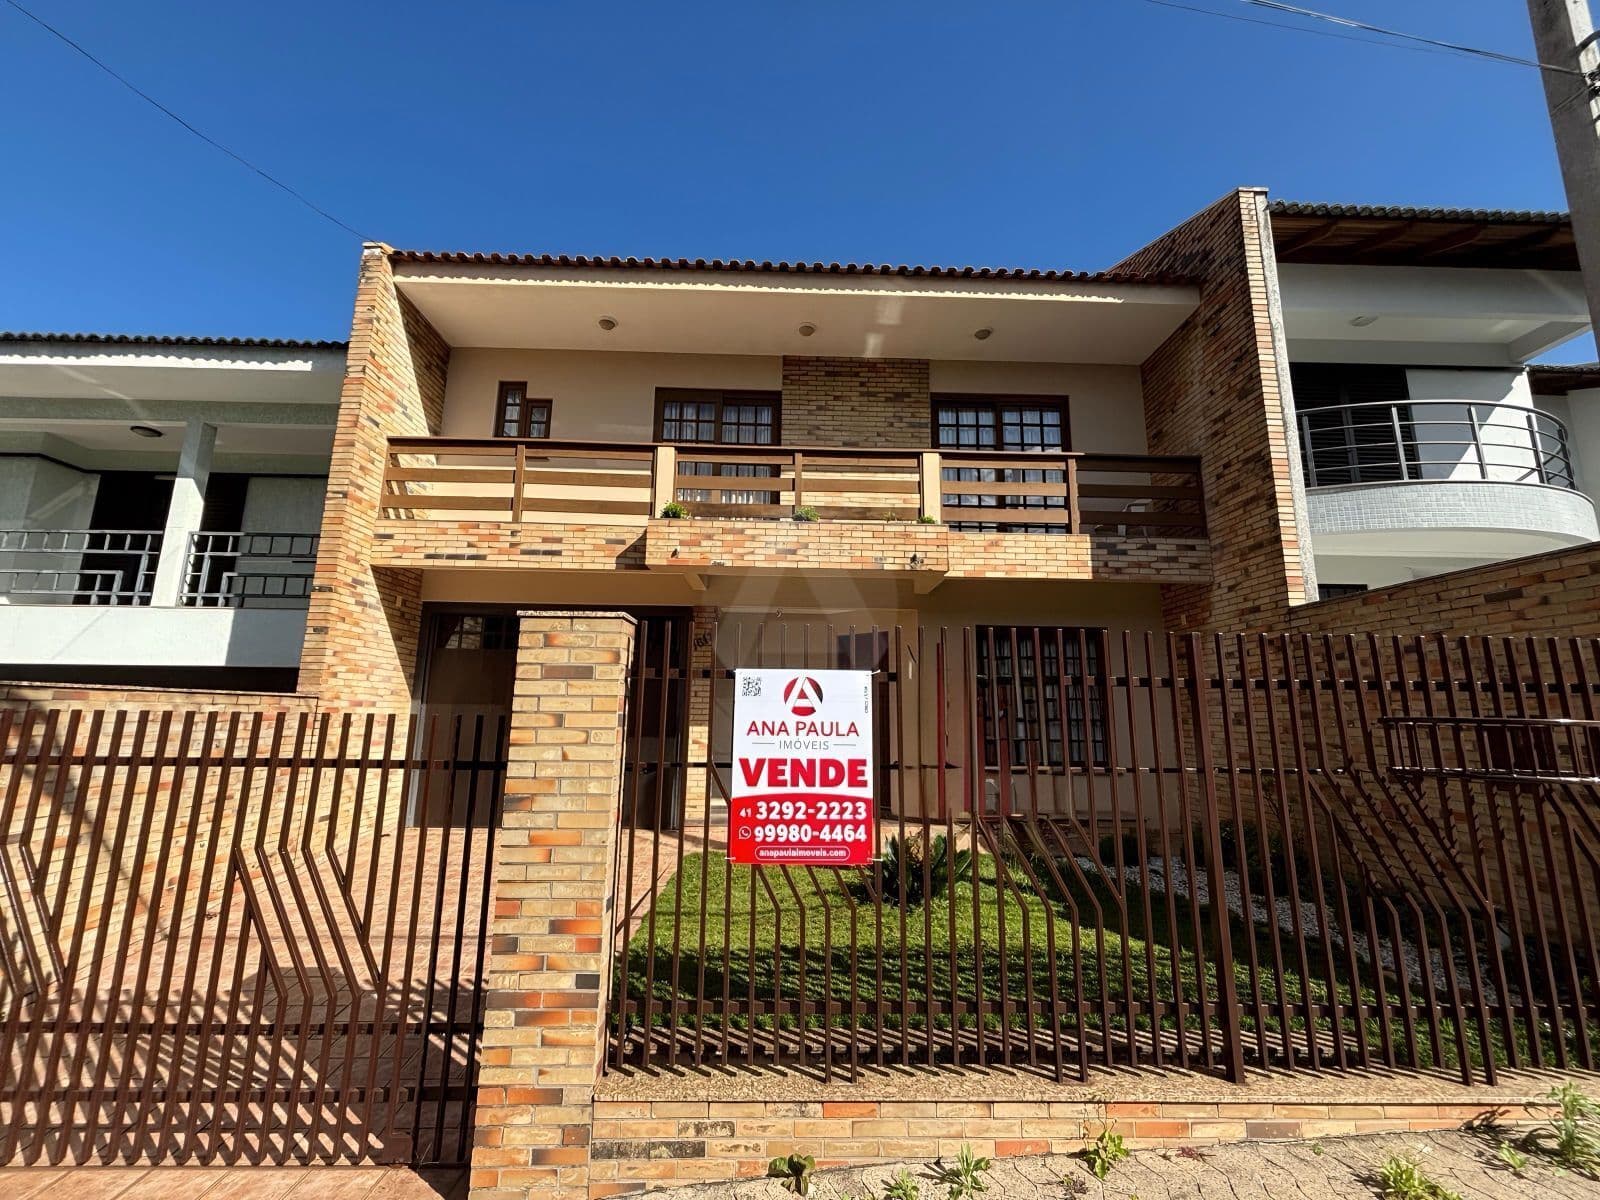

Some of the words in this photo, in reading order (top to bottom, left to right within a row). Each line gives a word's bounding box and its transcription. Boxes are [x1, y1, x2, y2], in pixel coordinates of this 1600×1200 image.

[746, 720, 790, 736] ANA
[795, 721, 860, 737] PAULA
[779, 738, 829, 750] IMÓVEIS
[738, 758, 868, 788] VENDE
[739, 808, 752, 818] 41
[755, 801, 867, 820] 3292-2223
[754, 824, 867, 842] 99980-4464
[758, 848, 847, 858] anapaulaimoveis.com
